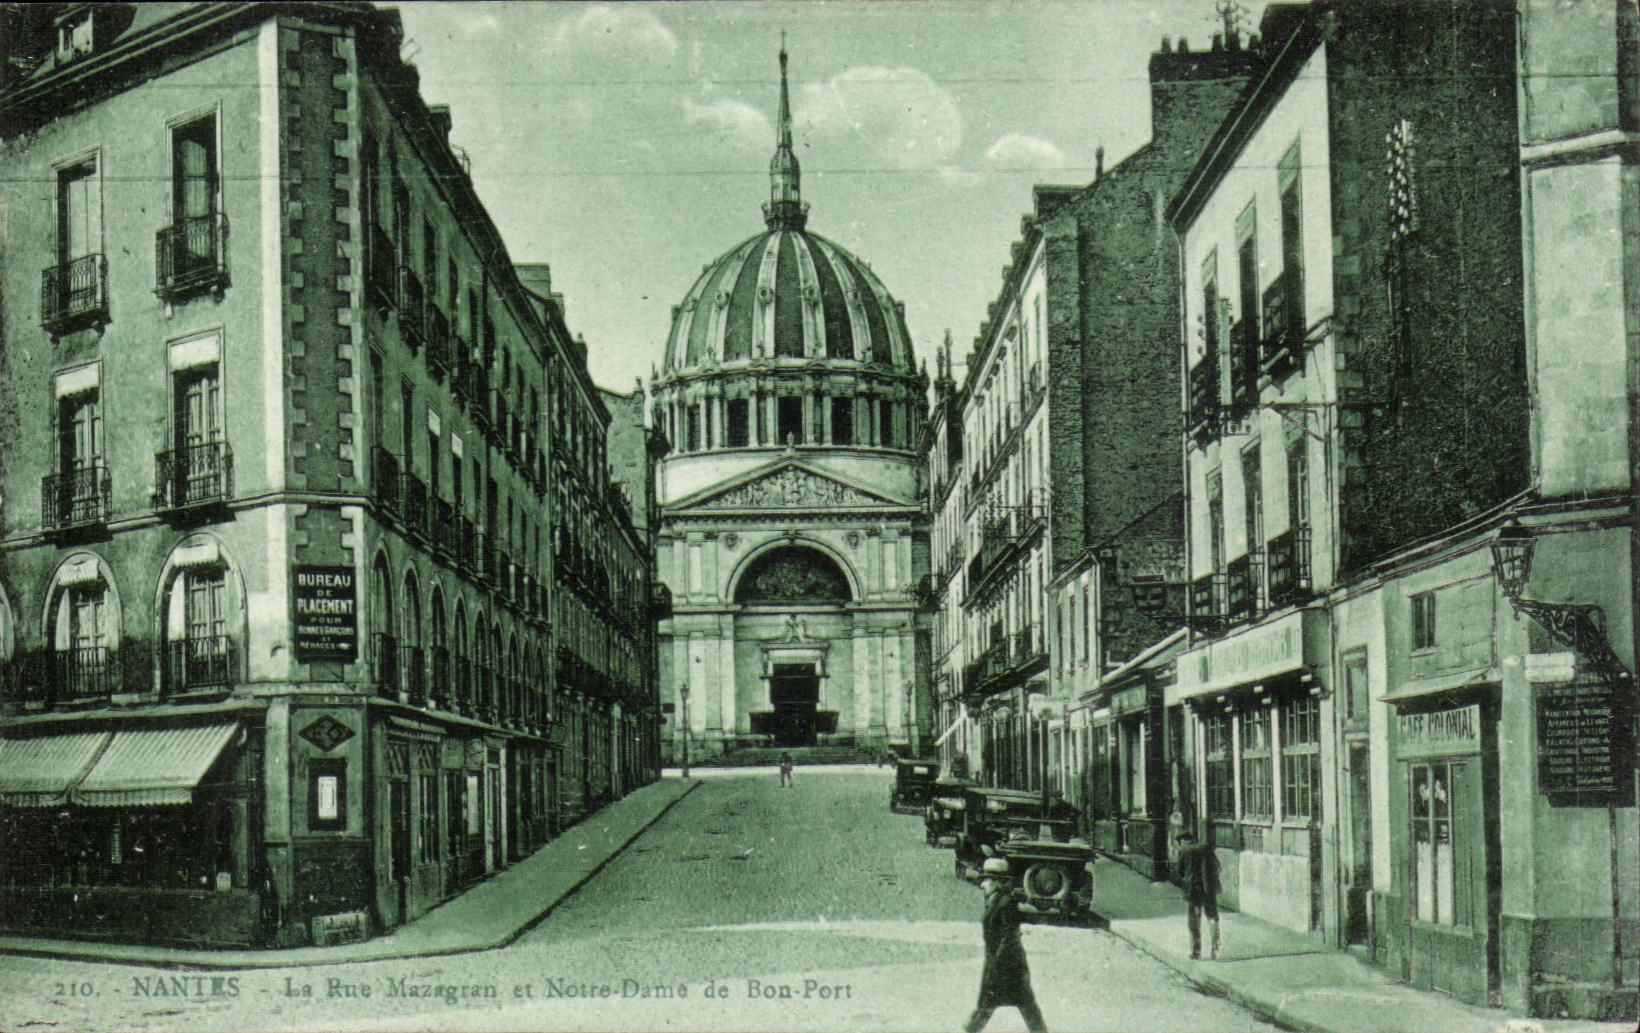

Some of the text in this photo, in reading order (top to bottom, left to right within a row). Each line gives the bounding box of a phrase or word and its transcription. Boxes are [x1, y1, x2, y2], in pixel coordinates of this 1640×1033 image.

[298, 573, 351, 587] BUREAU
[316, 589, 333, 597] DE
[297, 598, 354, 615] PLACEMENT
[310, 616, 343, 624] POUR
[1428, 708, 1476, 741] COLONIAL
